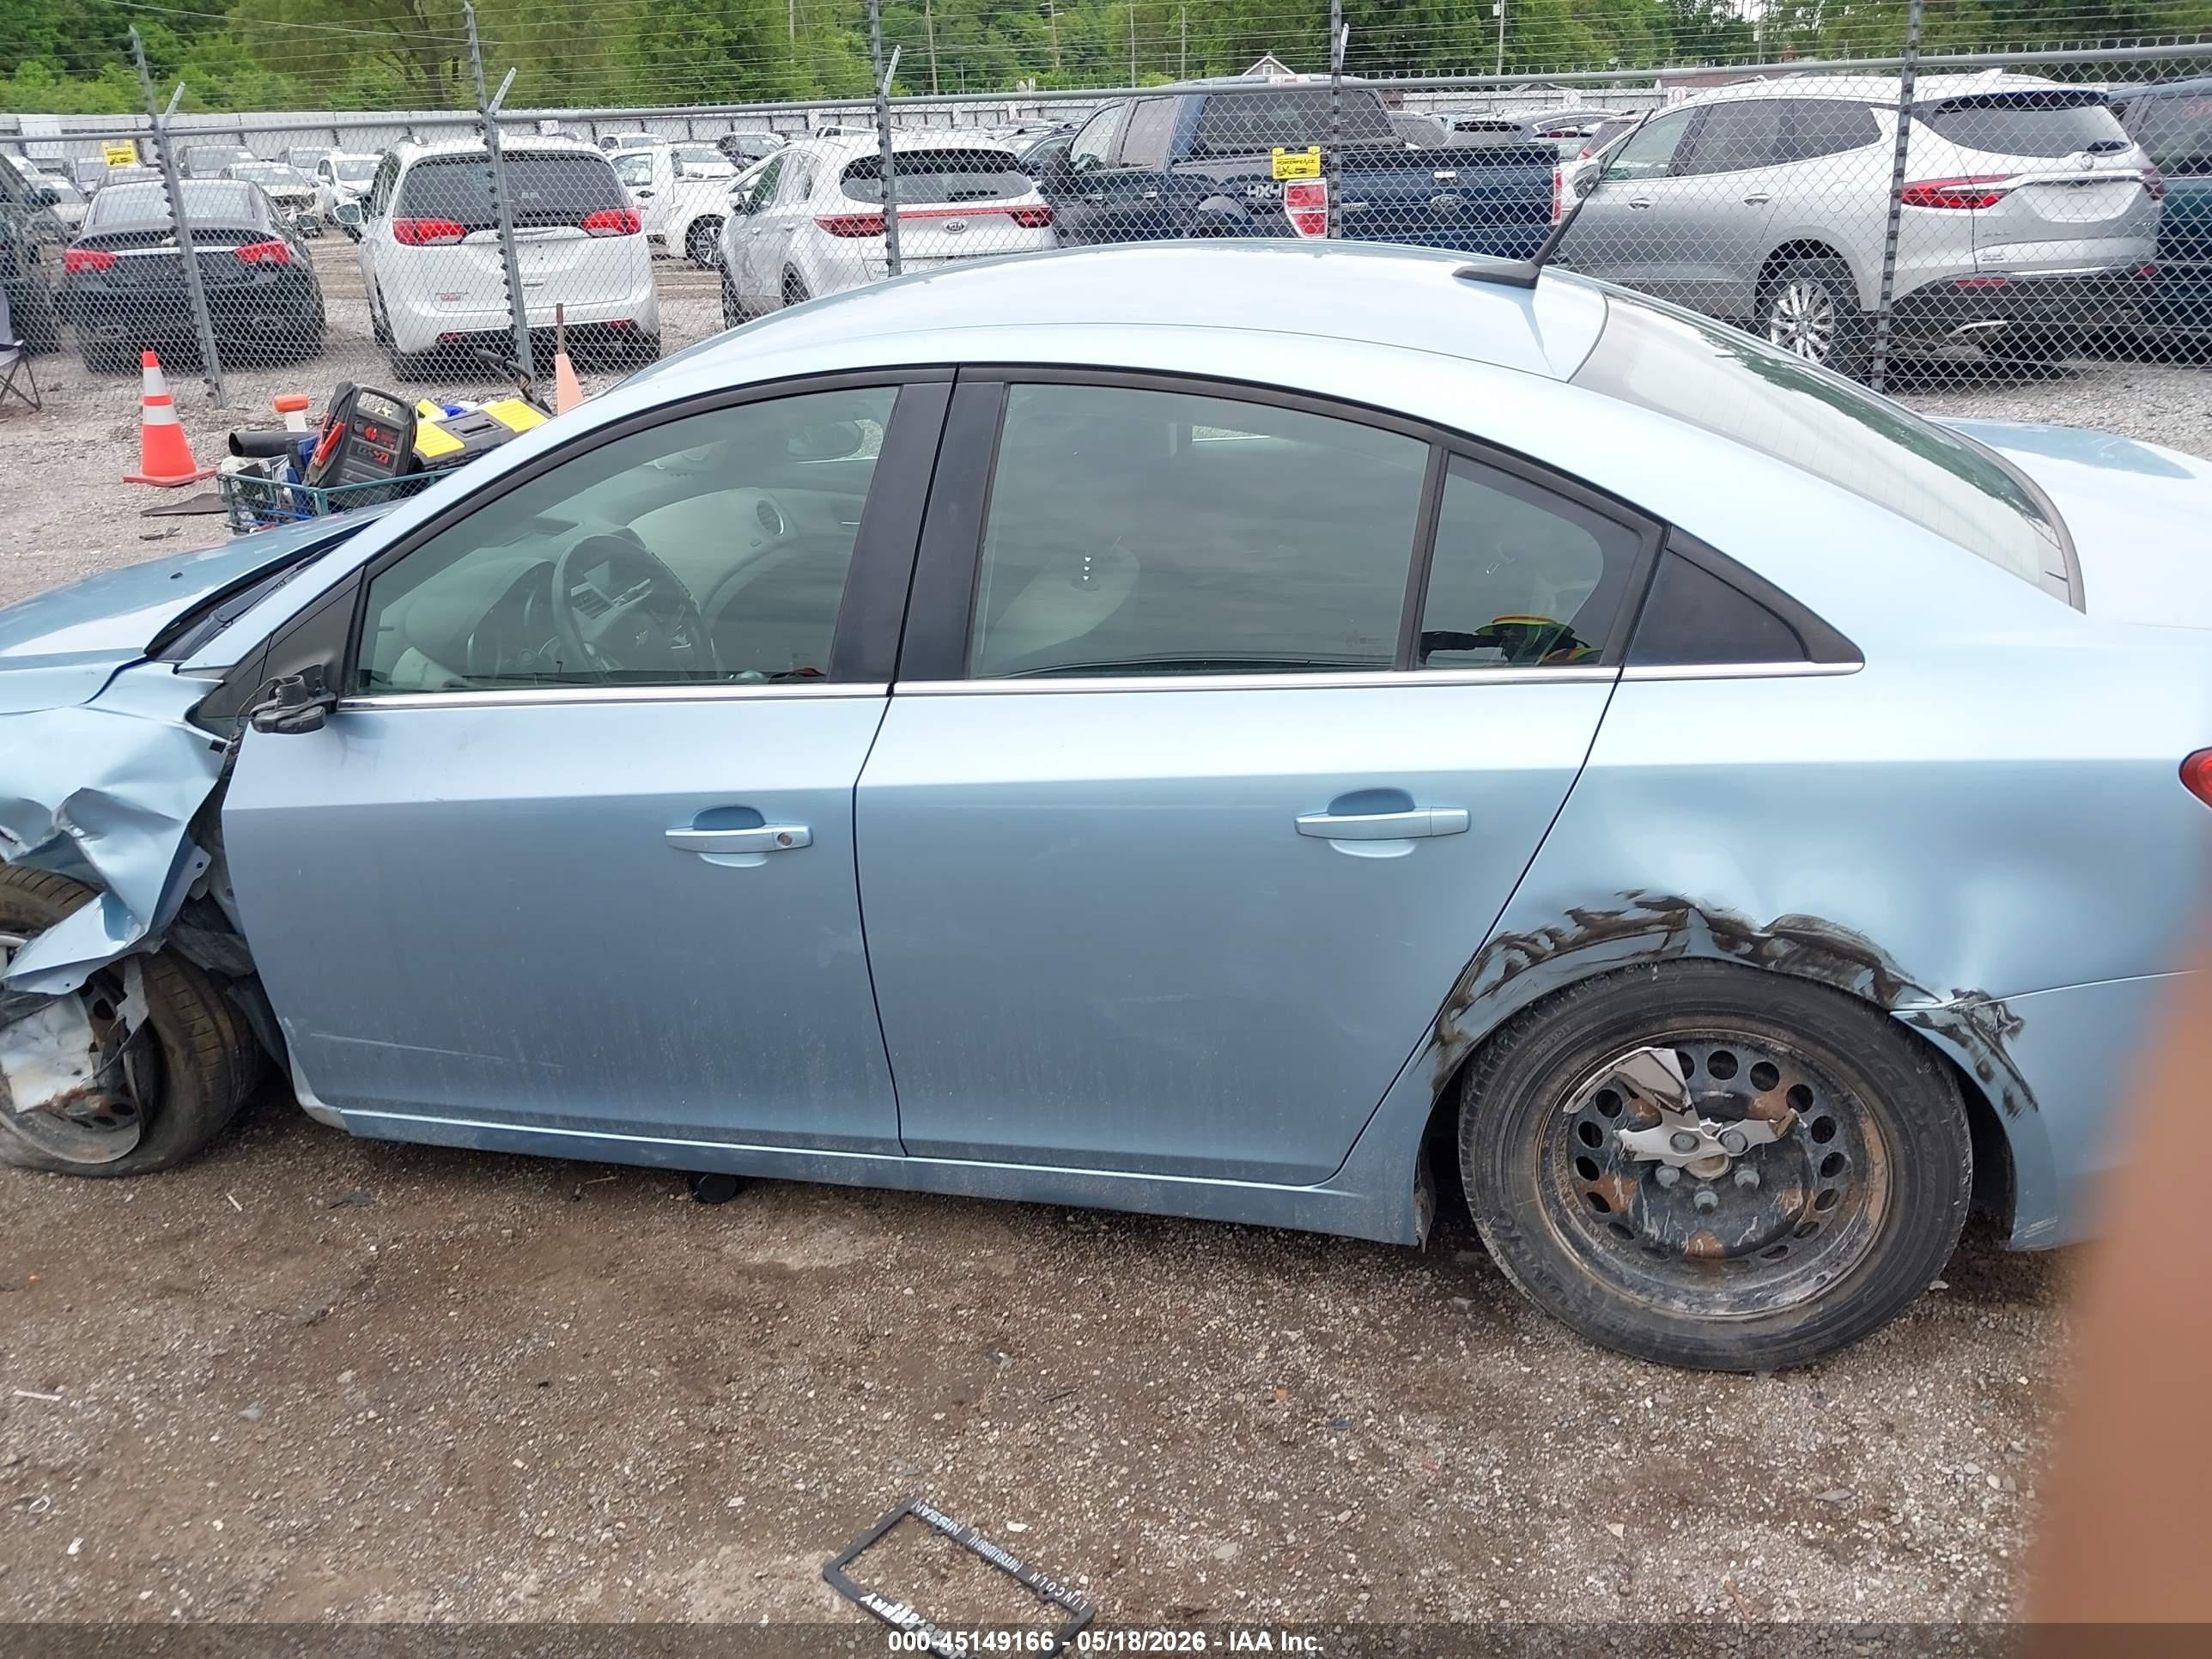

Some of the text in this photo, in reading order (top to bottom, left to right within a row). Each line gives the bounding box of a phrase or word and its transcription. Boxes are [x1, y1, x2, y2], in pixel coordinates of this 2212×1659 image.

[911, 1498, 1090, 1612] LINCOLN MITSUBISHI NISSAN
